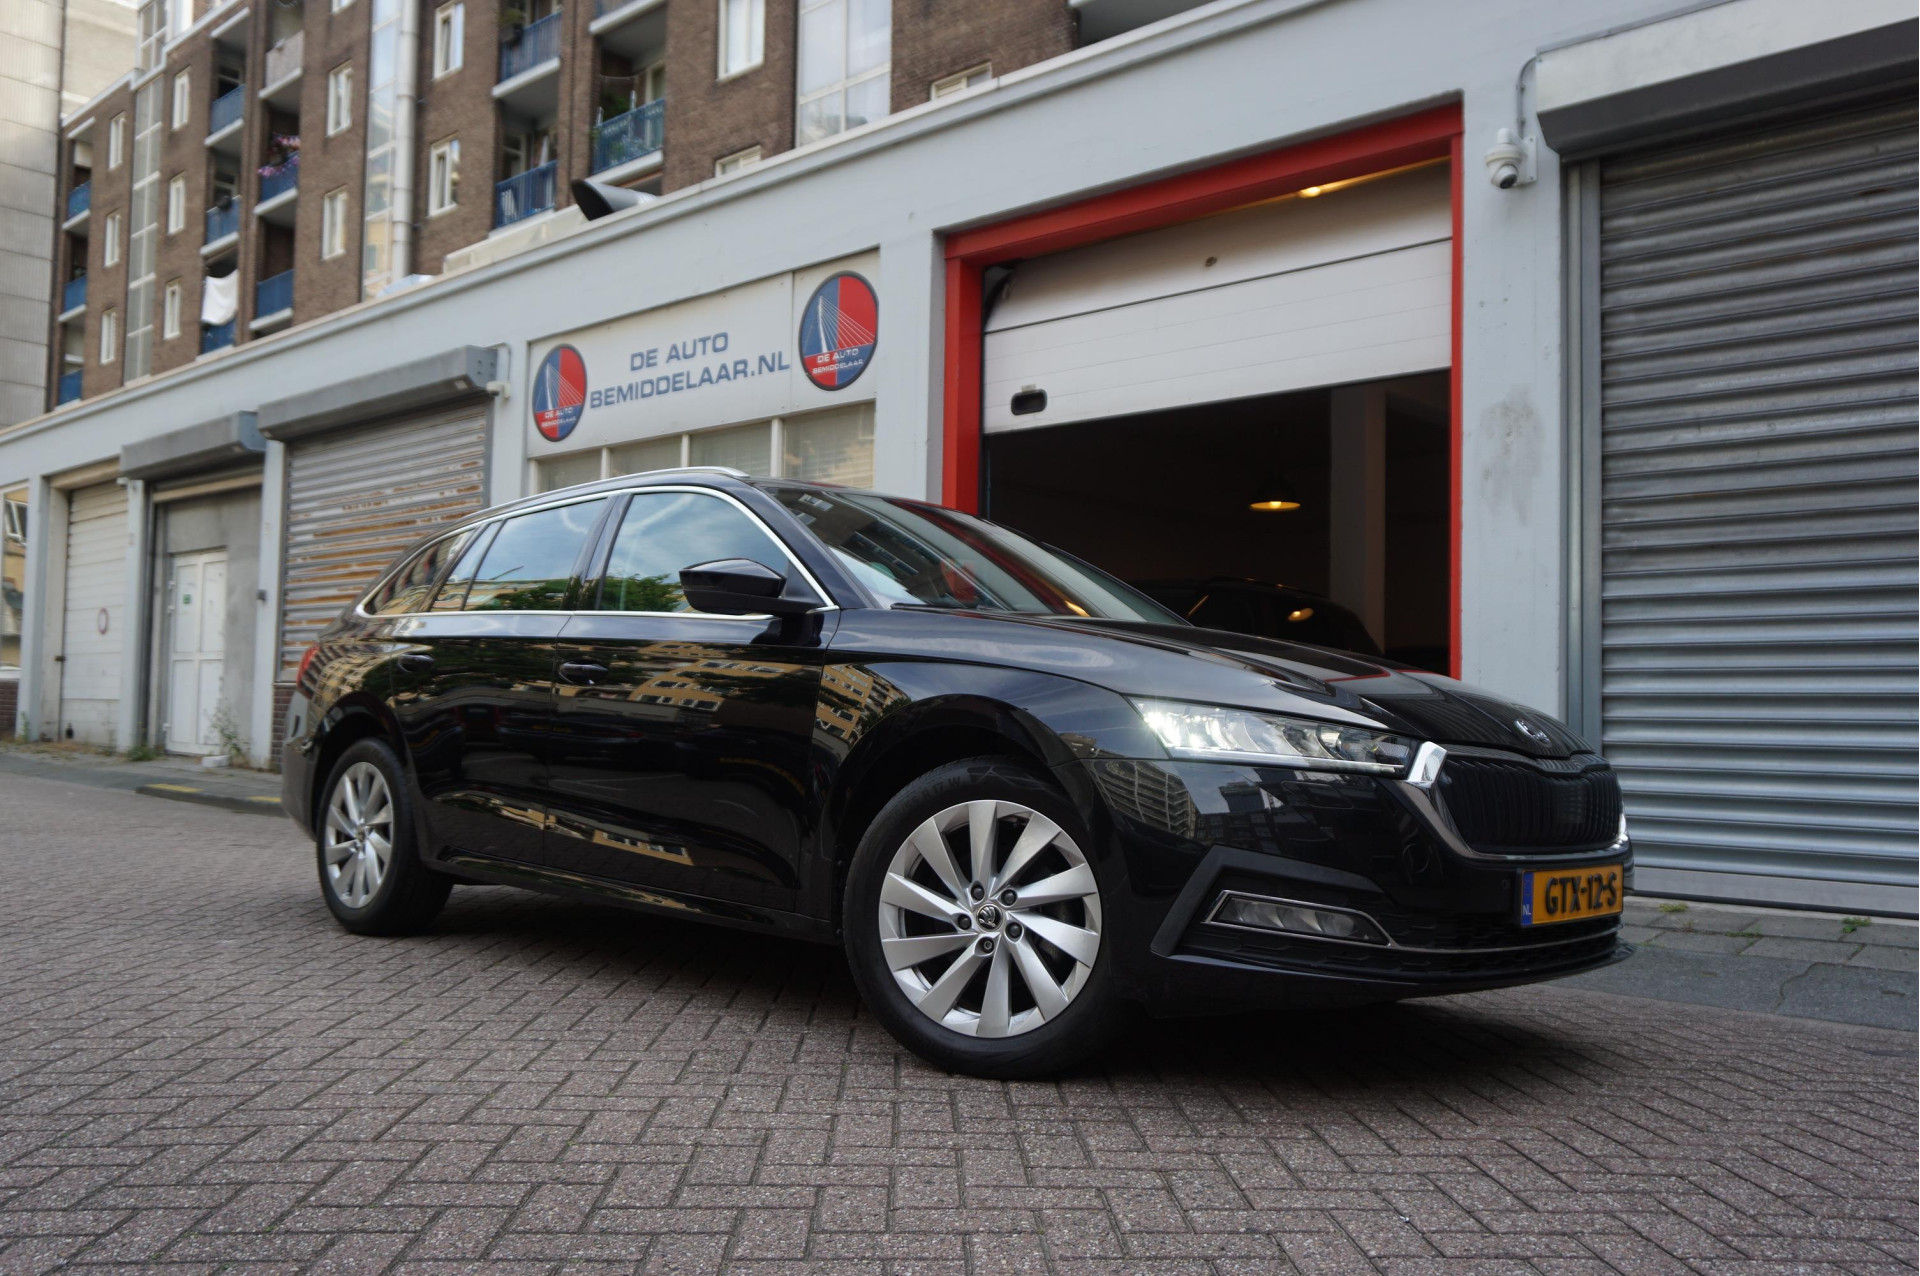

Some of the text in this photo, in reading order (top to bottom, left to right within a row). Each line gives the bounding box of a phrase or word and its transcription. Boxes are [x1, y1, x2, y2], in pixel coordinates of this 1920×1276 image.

[630, 332, 729, 371] DE AUTO
[817, 348, 859, 363] DE AUTO
[812, 358, 864, 374] BEMIDDELAAR
[590, 351, 790, 409] BEMIDDELAAR.NL
[1545, 871, 1618, 915] GTX-12-S
[1522, 903, 1532, 916] NL
